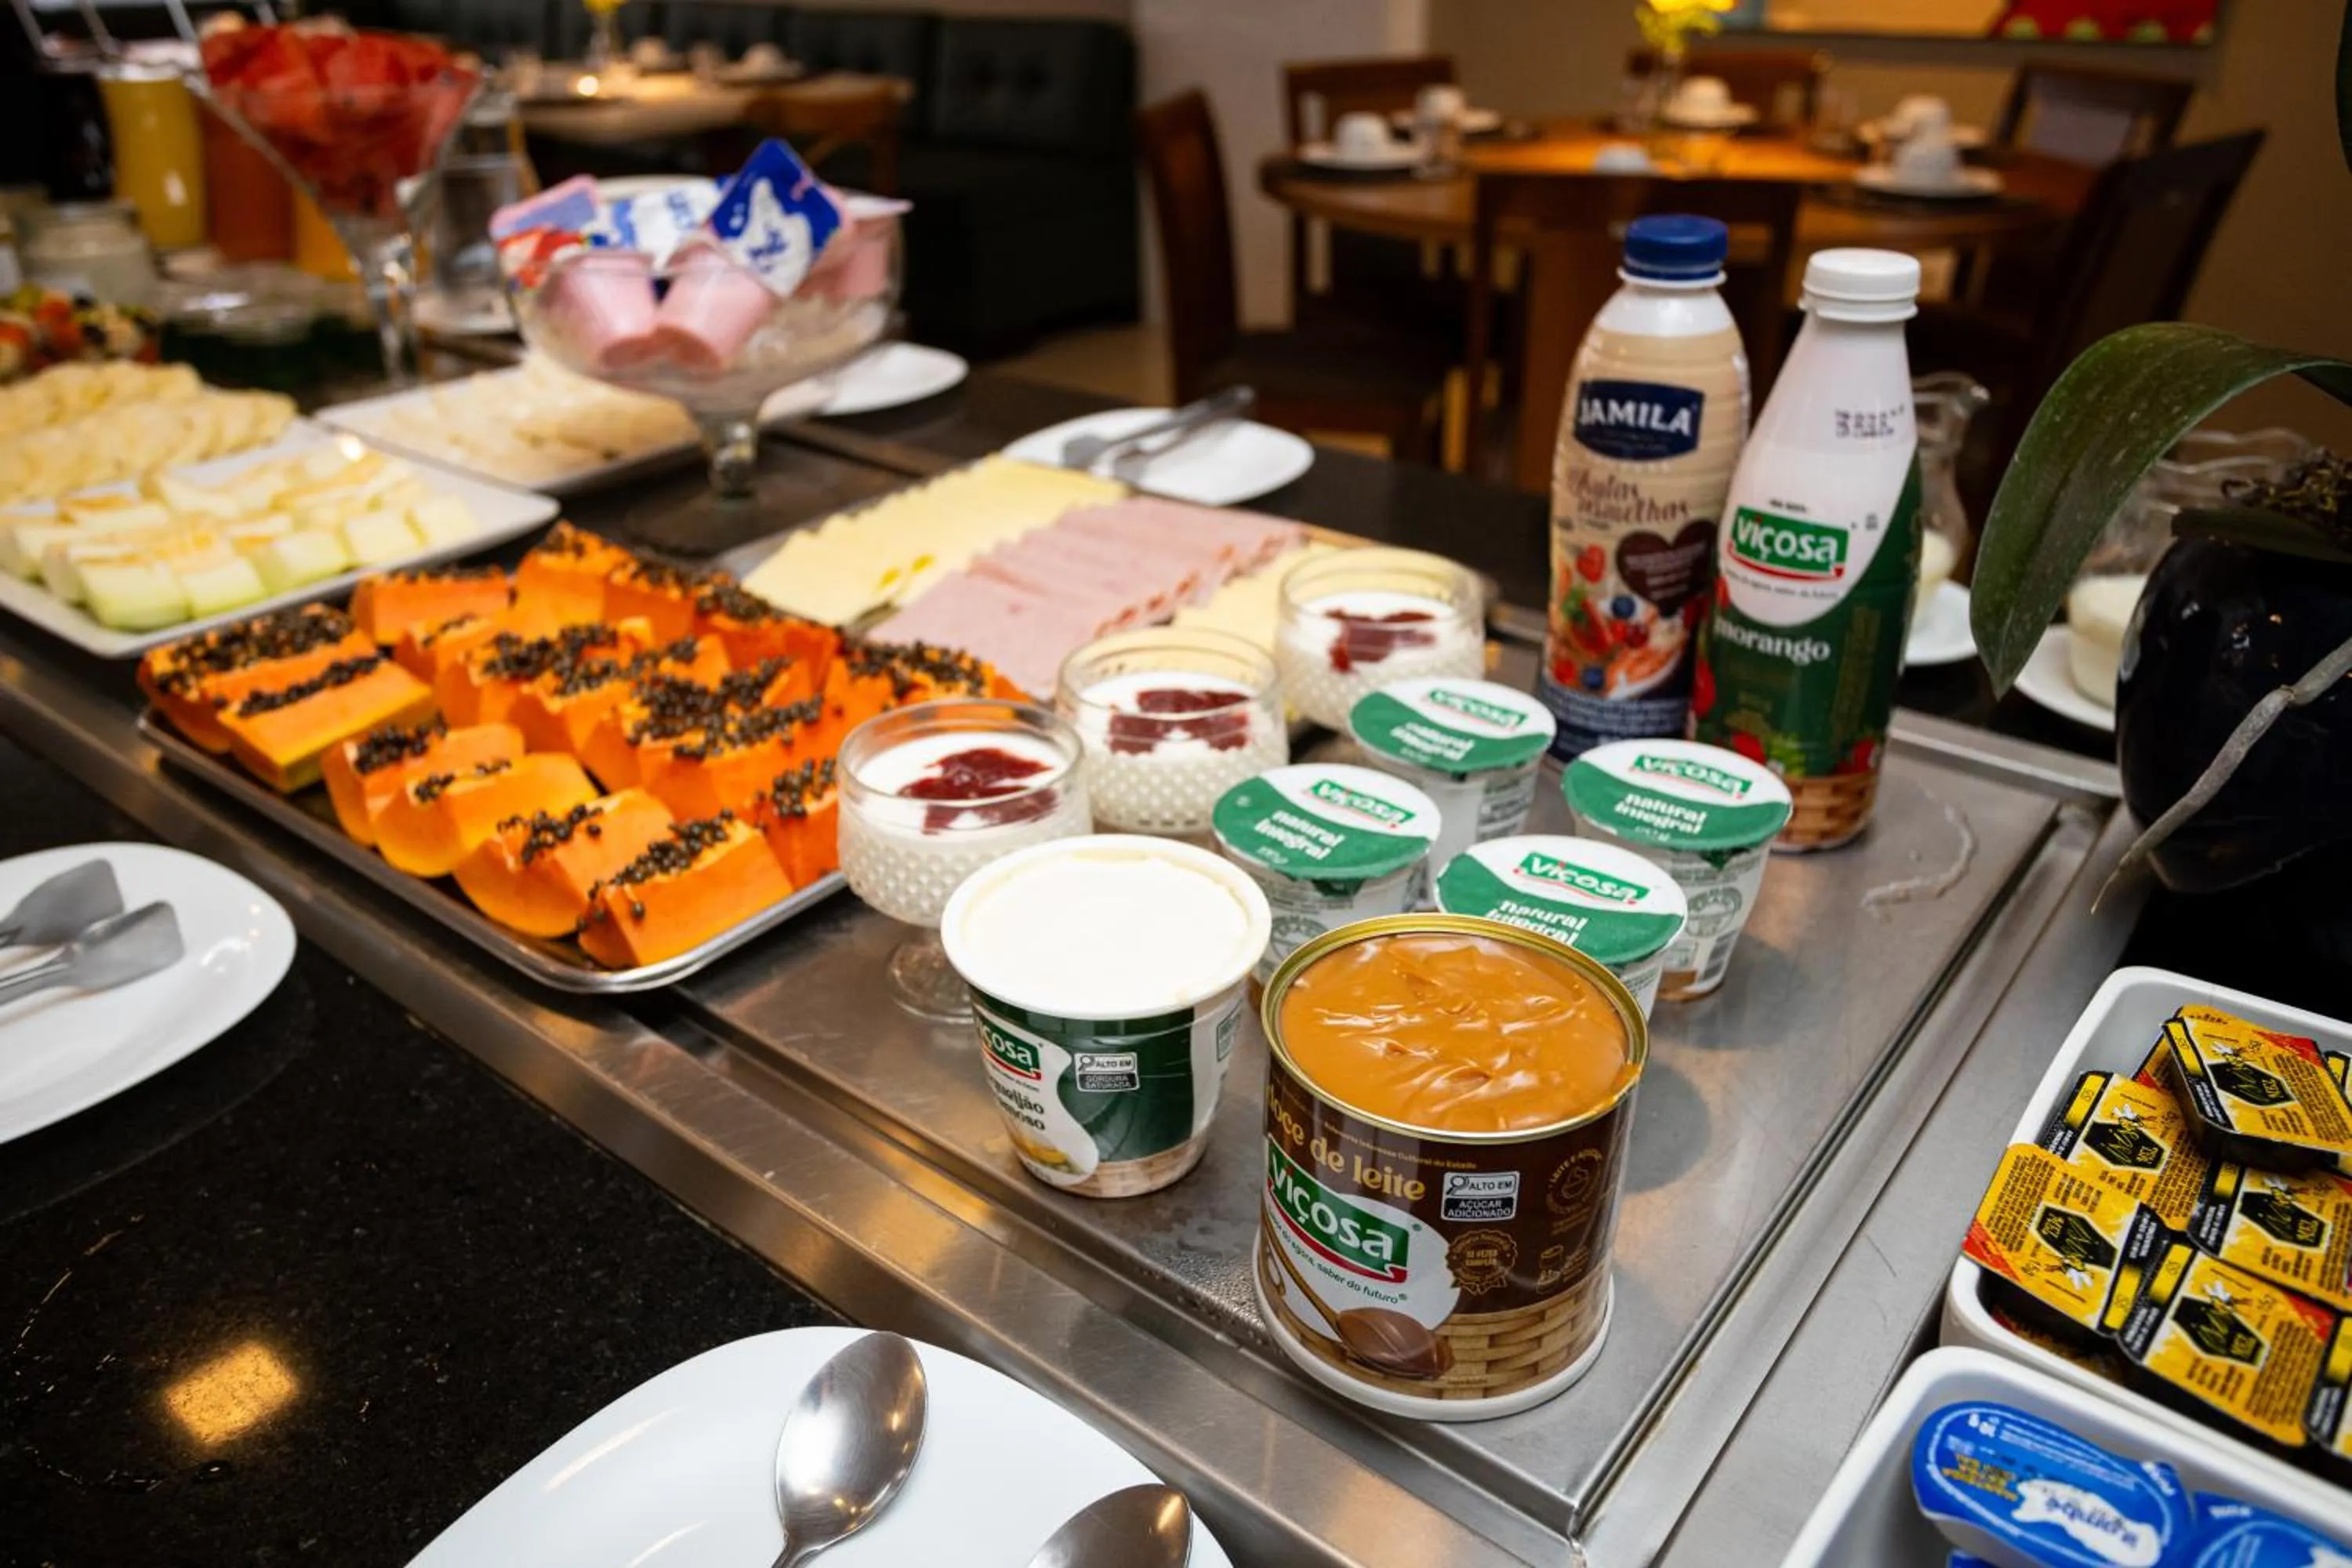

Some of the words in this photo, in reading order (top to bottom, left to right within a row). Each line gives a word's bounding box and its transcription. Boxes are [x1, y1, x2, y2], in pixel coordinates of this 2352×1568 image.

[1579, 397, 1692, 437] JAMILA
[1715, 615, 1831, 666] morango
[1614, 801, 1703, 834] integral
[1625, 793, 1708, 822] natural
[1254, 817, 1332, 860] integral
[1271, 810, 1346, 848] natural
[1500, 900, 1589, 931] natural
[1310, 1137, 1345, 1174] de
[1353, 1154, 1426, 1201] leite
[1468, 1181, 1495, 1191] ALTO
[1497, 1180, 1513, 1190] EM
[1447, 1208, 1512, 1219] ADICIONADO
[1317, 1262, 1346, 1284] saber
[1347, 1279, 1361, 1292] do
